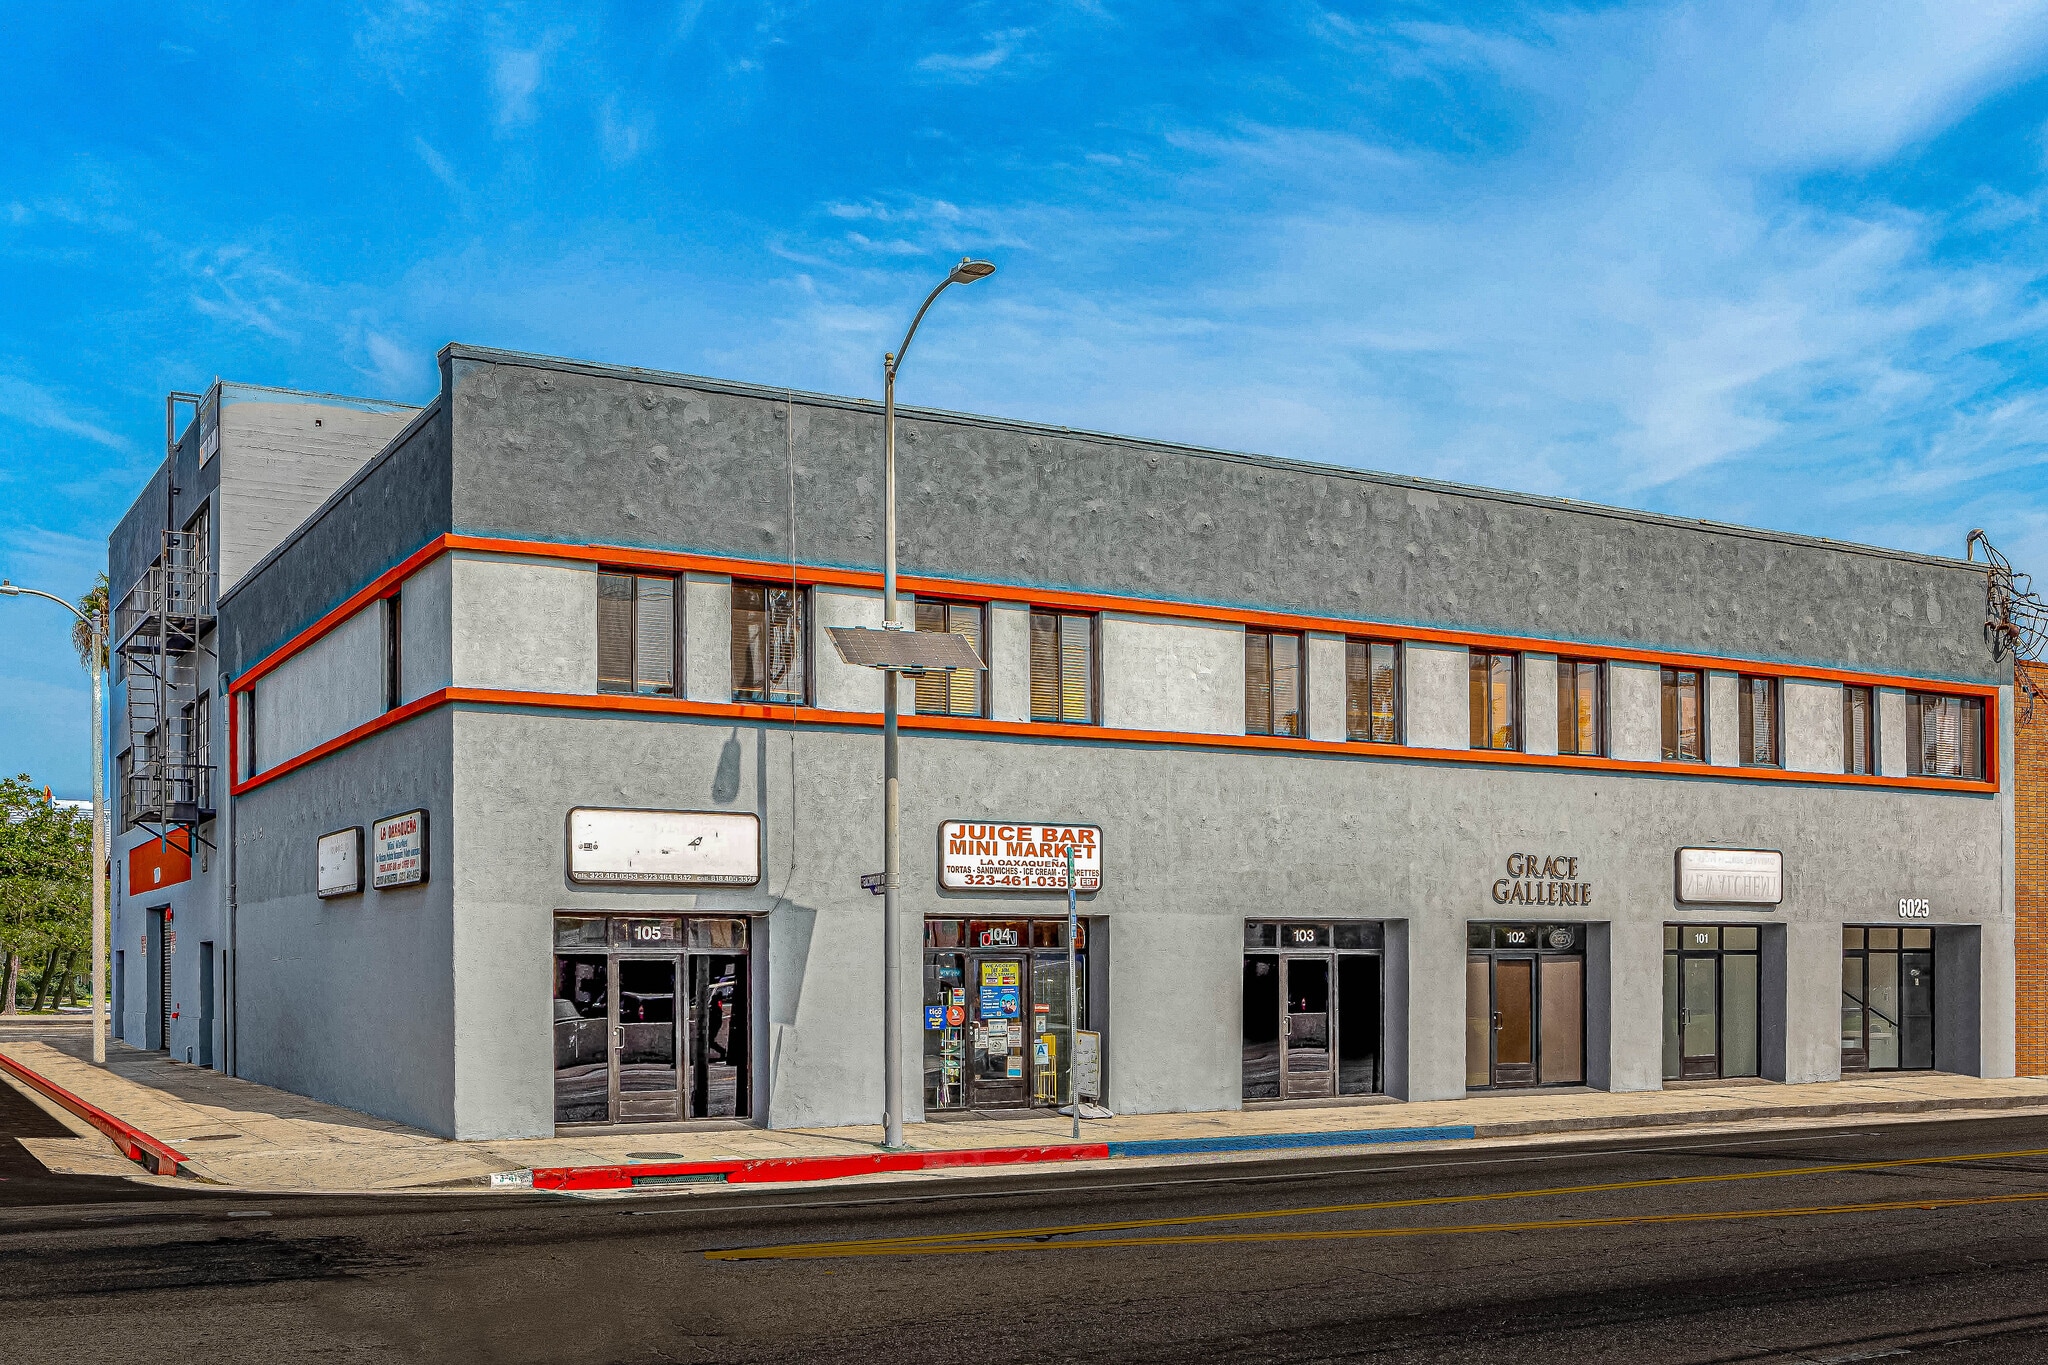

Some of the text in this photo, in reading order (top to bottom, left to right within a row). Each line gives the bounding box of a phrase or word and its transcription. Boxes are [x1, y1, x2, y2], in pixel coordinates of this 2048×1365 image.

[951, 825, 1095, 844] JUICE BAR
[949, 840, 1096, 859] MINI MARKET
[998, 859, 1067, 868] OAXAQUEÑA
[1506, 852, 1578, 879] GRACE
[947, 866, 972, 874] TORTAS
[977, 867, 1019, 875] SANDWICHES
[1023, 868, 1034, 876] ICE
[1035, 868, 1057, 876] CREAM
[1492, 879, 1592, 907] GALLERIE
[1899, 898, 1930, 917] 6025
[634, 926, 661, 940] 105
[988, 928, 1010, 941] 104
[1293, 929, 1314, 942] 103
[1507, 931, 1526, 943] 102
[1695, 933, 1709, 944] 101
[1037, 1045, 1045, 1055] A
